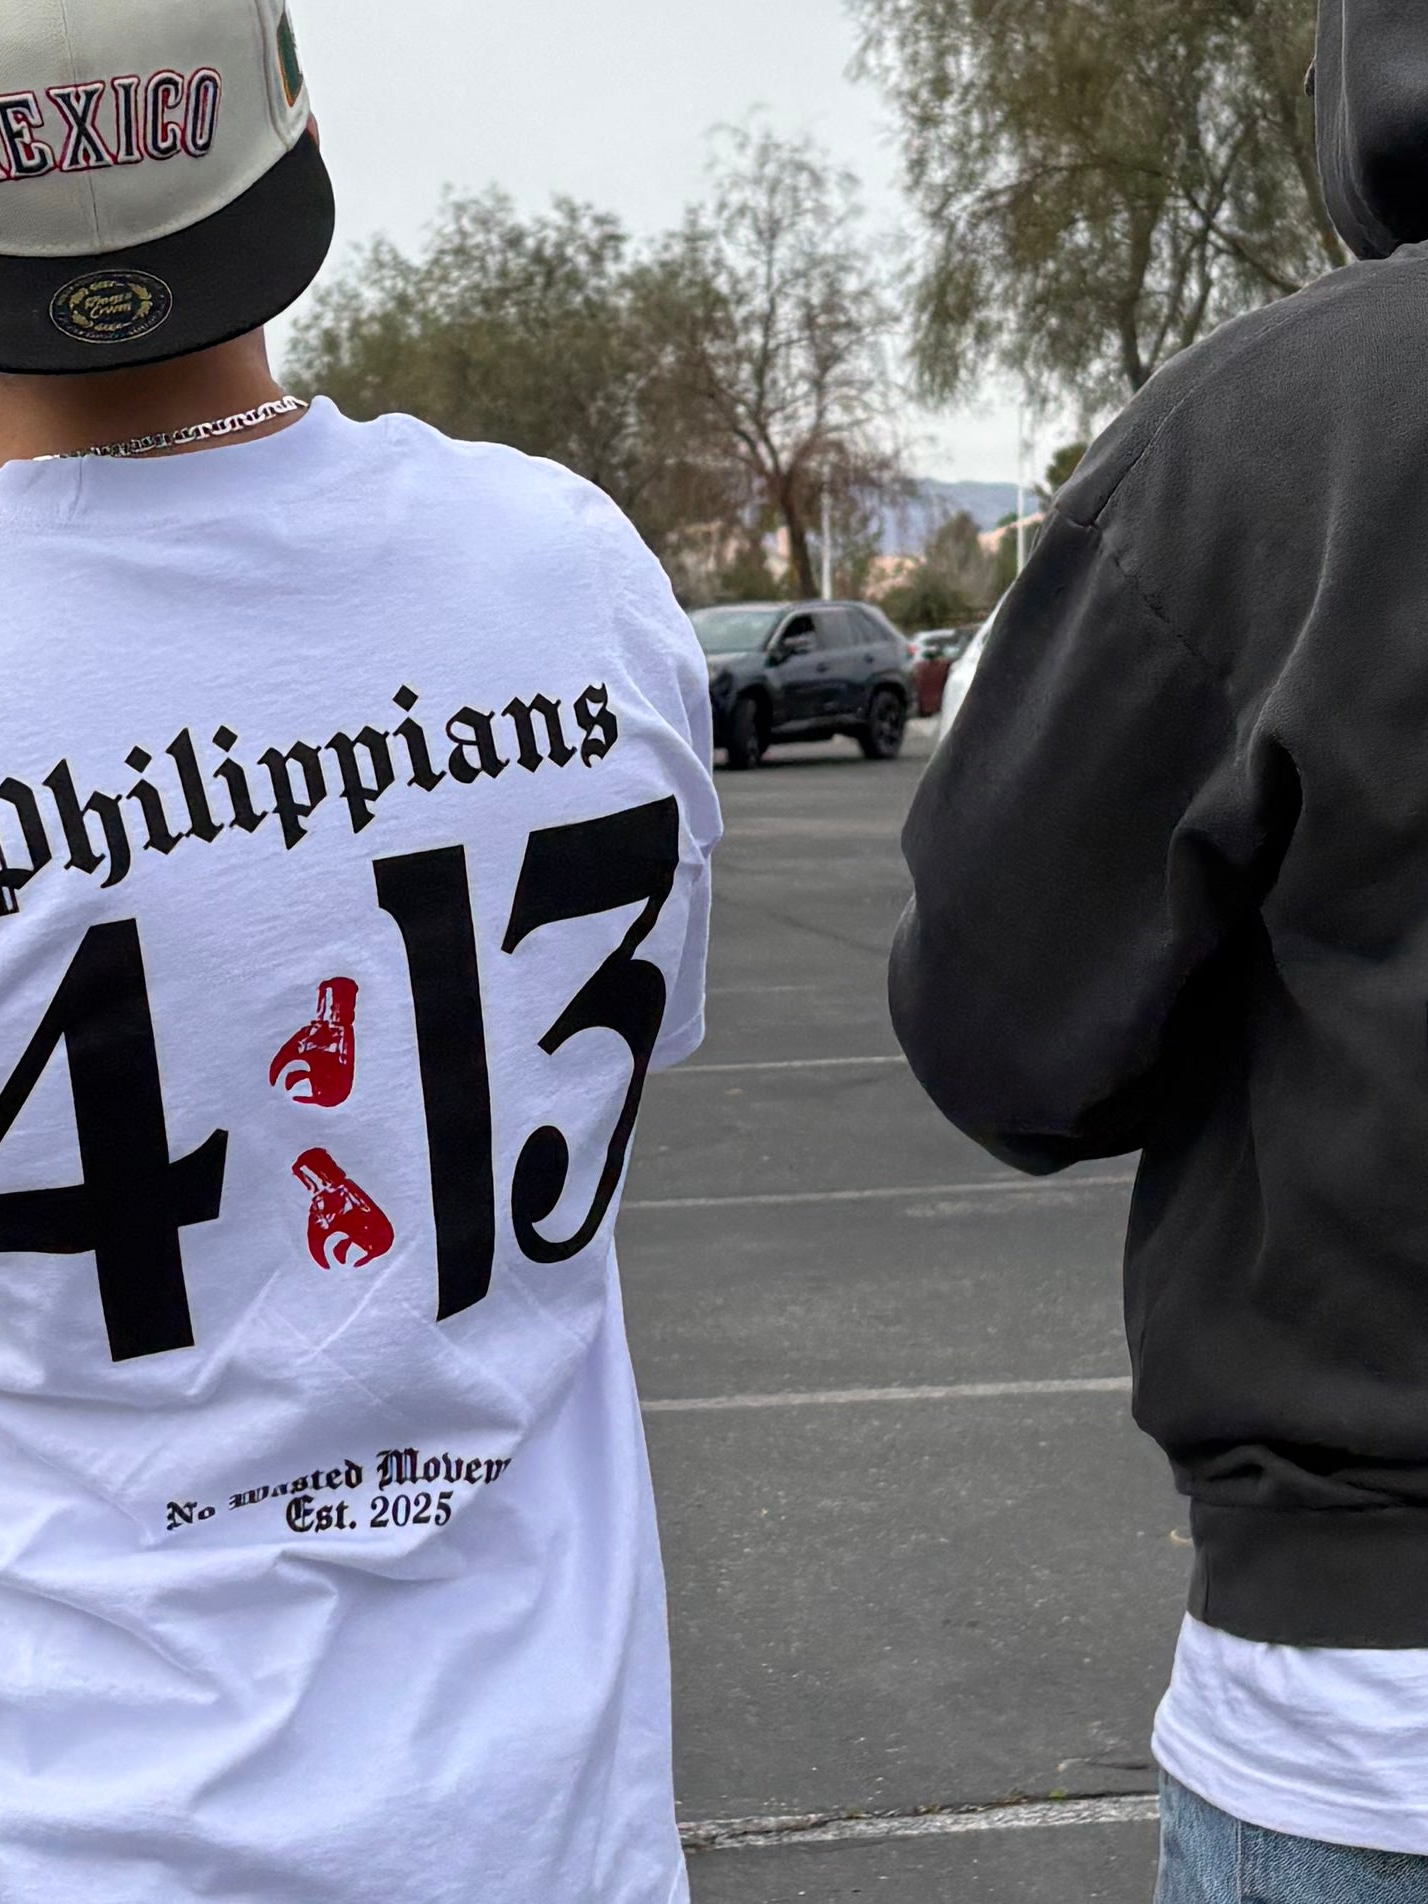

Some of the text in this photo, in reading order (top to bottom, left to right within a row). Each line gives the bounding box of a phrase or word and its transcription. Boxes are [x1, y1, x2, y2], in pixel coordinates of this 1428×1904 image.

[166, 1500, 216, 1531] No
[286, 1491, 455, 1534] Est. 2025
